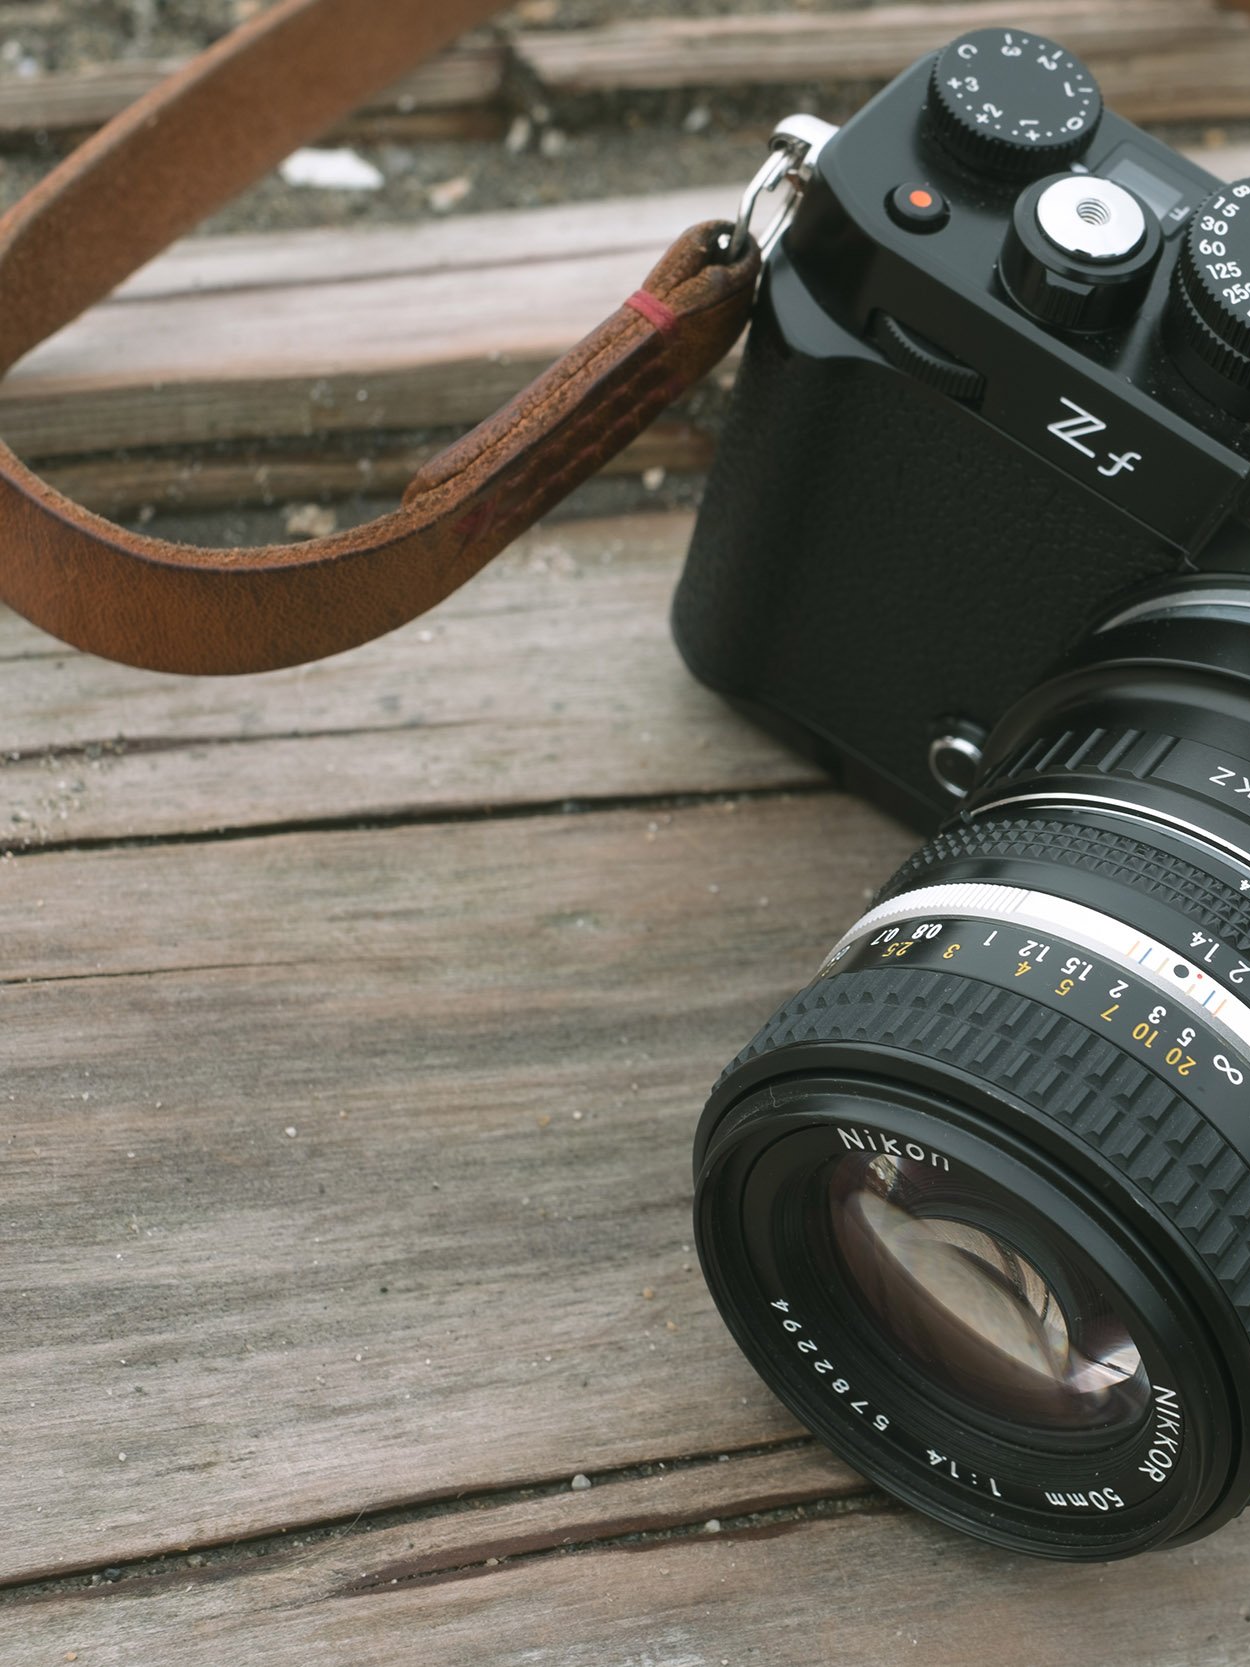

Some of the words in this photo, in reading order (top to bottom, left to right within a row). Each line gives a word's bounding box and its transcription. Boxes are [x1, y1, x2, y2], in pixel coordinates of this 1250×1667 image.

[957, 44, 978, 59] C
[1066, 117, 1084, 130] 0
[1232, 184, 1250, 198] 8
[1213, 196, 1240, 218] 15
[1200, 215, 1229, 235] 30
[1199, 239, 1226, 257] 60
[1205, 261, 1243, 280] 125
[1208, 766, 1236, 786] Z
[911, 923, 943, 940] 0.8
[983, 930, 998, 946] 1
[943, 943, 961, 959] 3
[1018, 939, 1050, 963] 1.2
[1189, 931, 1220, 963] 1.4
[1014, 961, 1032, 977] 4
[1061, 957, 1093, 982] 1.5
[1229, 960, 1250, 984] 2
[1054, 978, 1074, 996] 5
[1109, 979, 1129, 999] 2
[1101, 1003, 1120, 1022] 7
[1148, 1005, 1167, 1024] 3
[1132, 1022, 1159, 1048] 10
[1176, 1027, 1196, 1047] 5
[1165, 1047, 1197, 1076] 20
[837, 1127, 950, 1172] Nikon
[770, 1299, 891, 1431] 5782294
[1138, 1384, 1180, 1483] NIKKOR
[1044, 1487, 1125, 1511] 50mm
